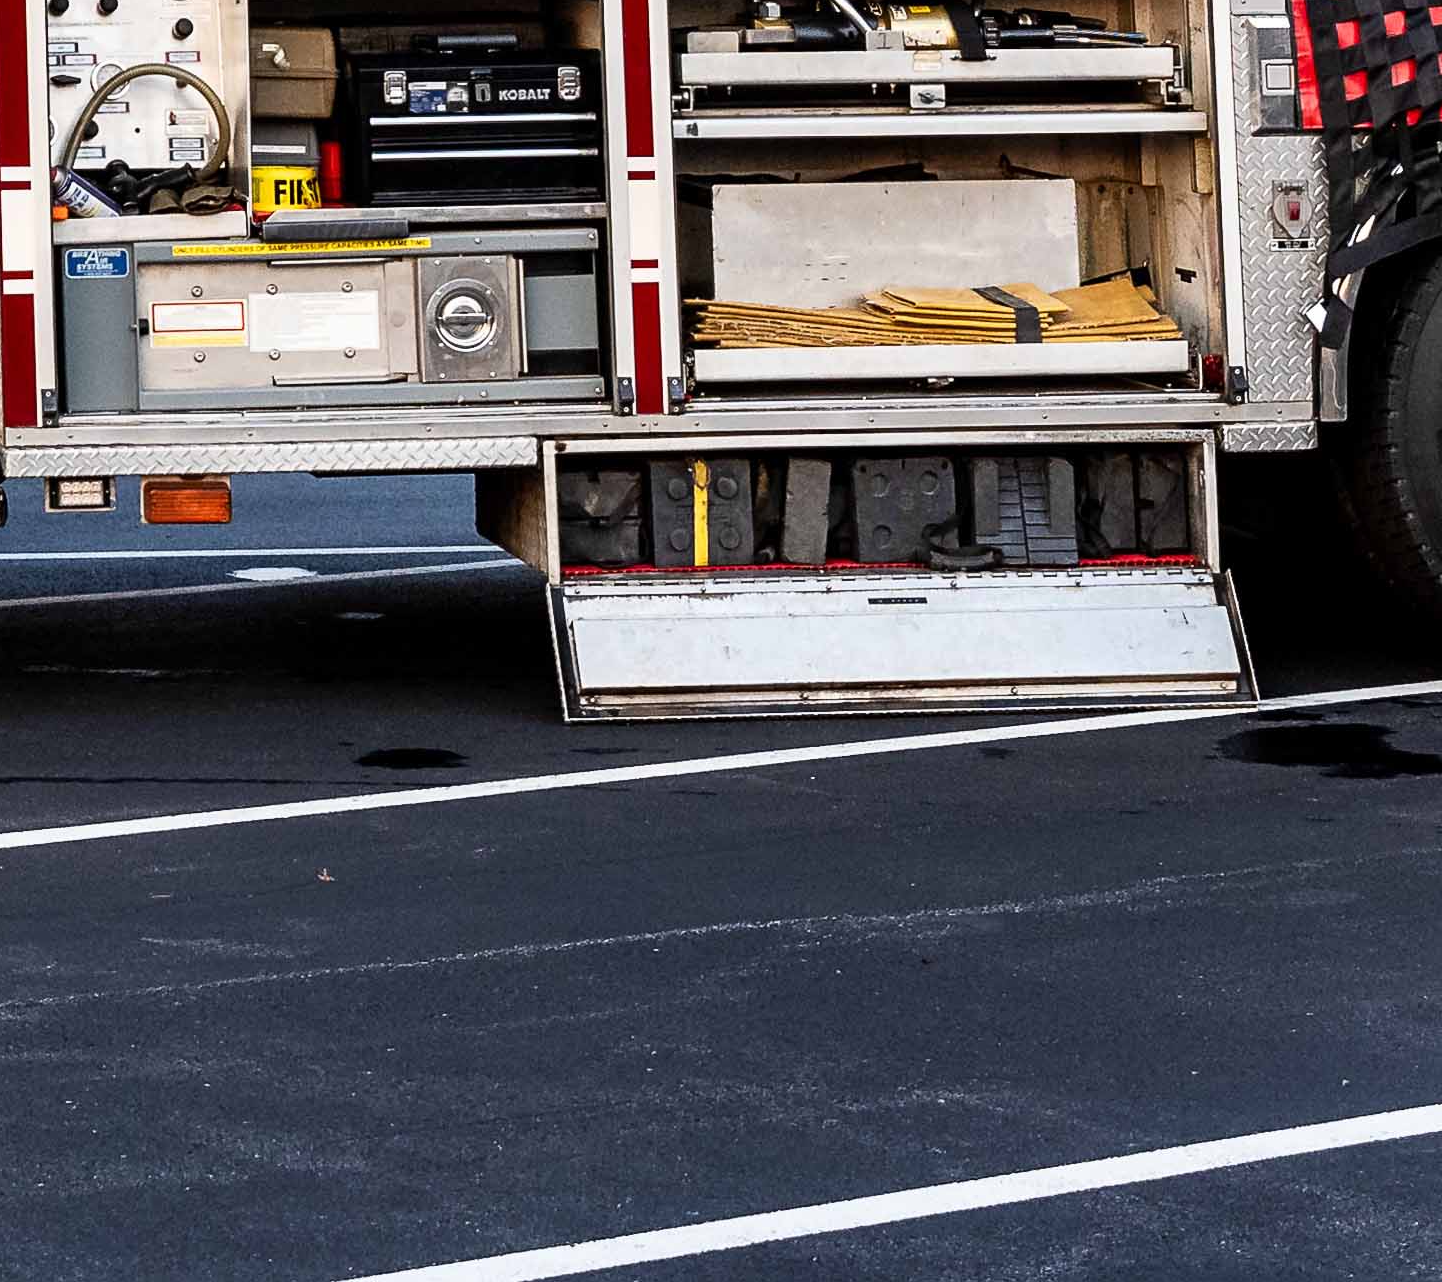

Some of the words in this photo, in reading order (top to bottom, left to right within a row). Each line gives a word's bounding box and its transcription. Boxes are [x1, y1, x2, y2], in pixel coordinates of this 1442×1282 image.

[499, 88, 551, 101] KOBALT
[268, 243, 288, 251] SAME
[290, 242, 330, 250] PRESSURE
[331, 241, 375, 249] CAPACITIES
[389, 239, 408, 247] SAME
[410, 238, 428, 246] TIME
